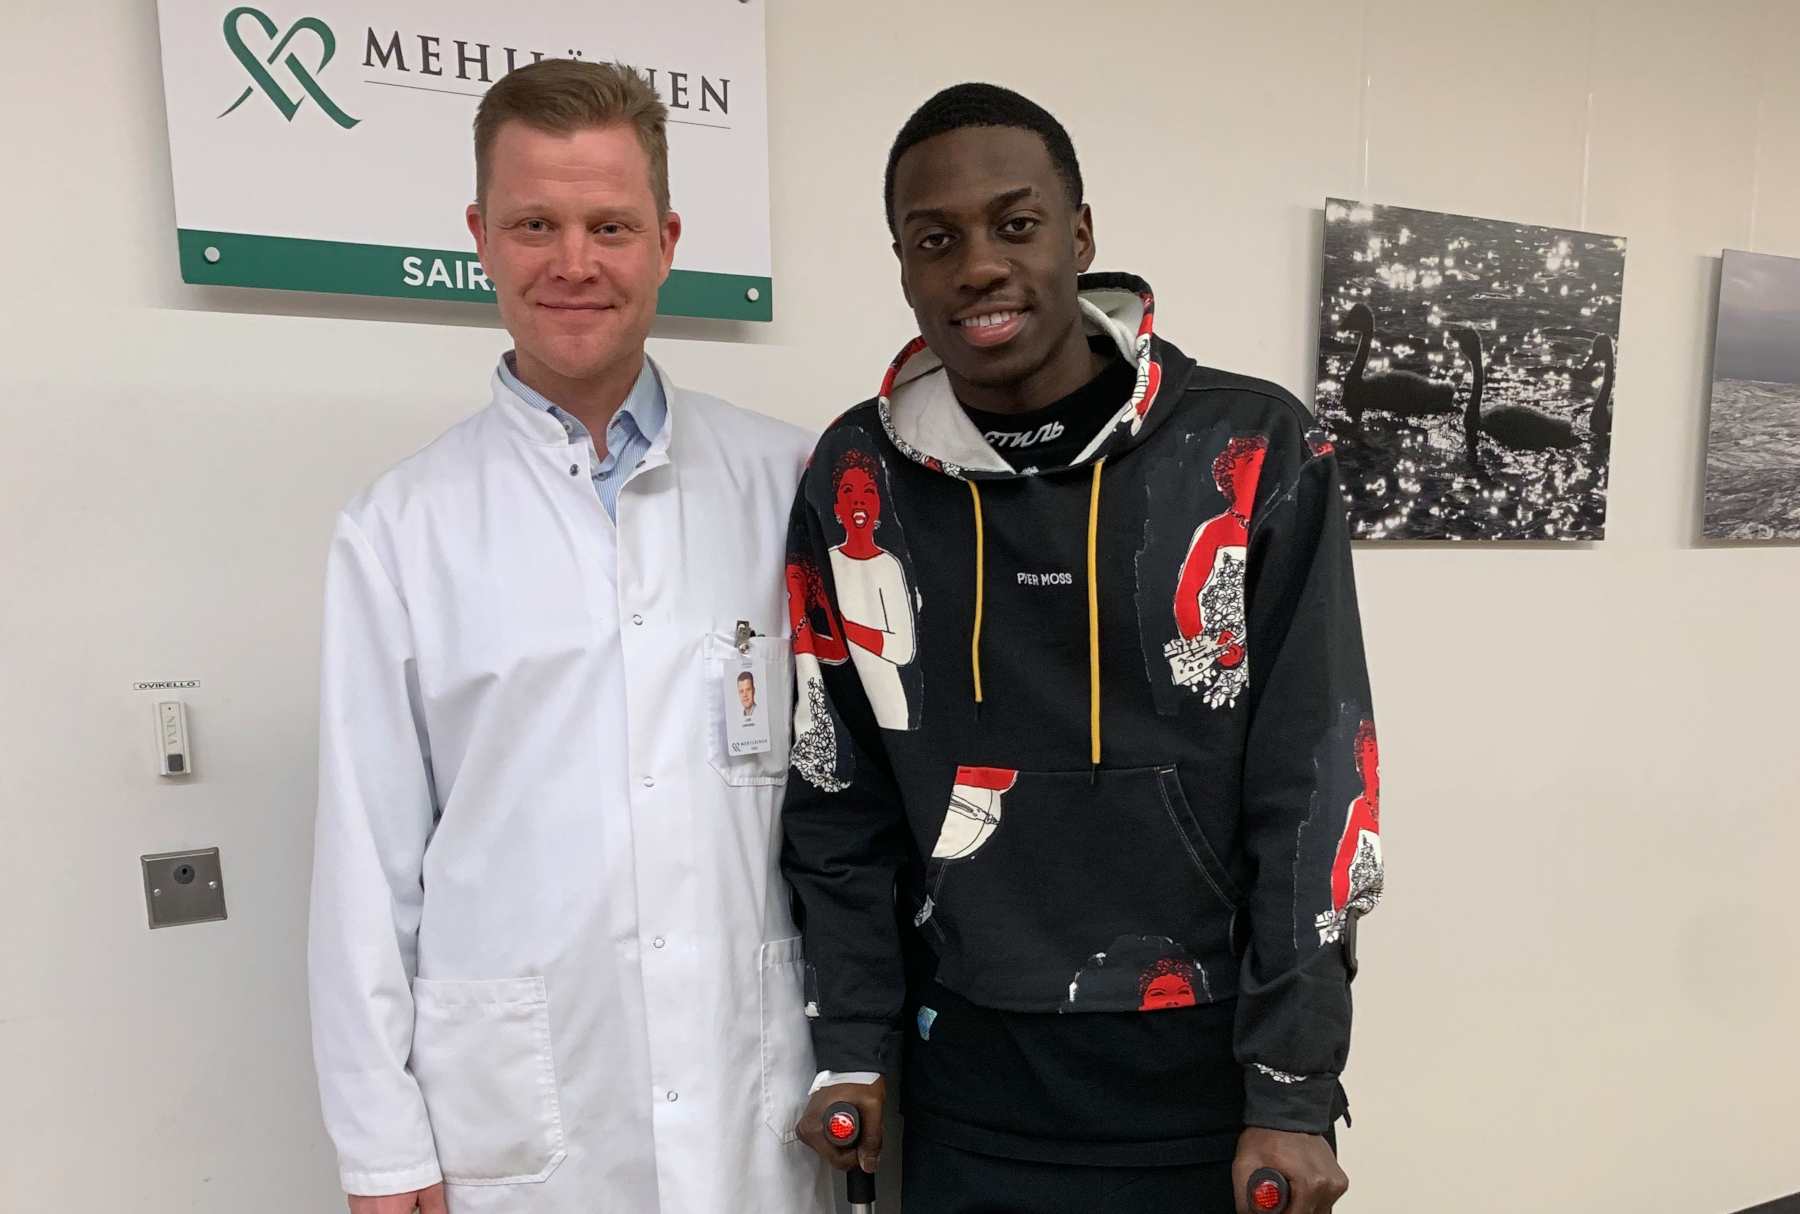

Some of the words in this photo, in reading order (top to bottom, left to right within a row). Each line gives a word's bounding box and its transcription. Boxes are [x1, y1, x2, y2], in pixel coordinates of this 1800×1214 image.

[362, 27, 730, 114] MEHIEN
[402, 256, 497, 291] SAIR
[1040, 572, 1072, 586] MOSS
[138, 681, 196, 689] OVIKELLO
